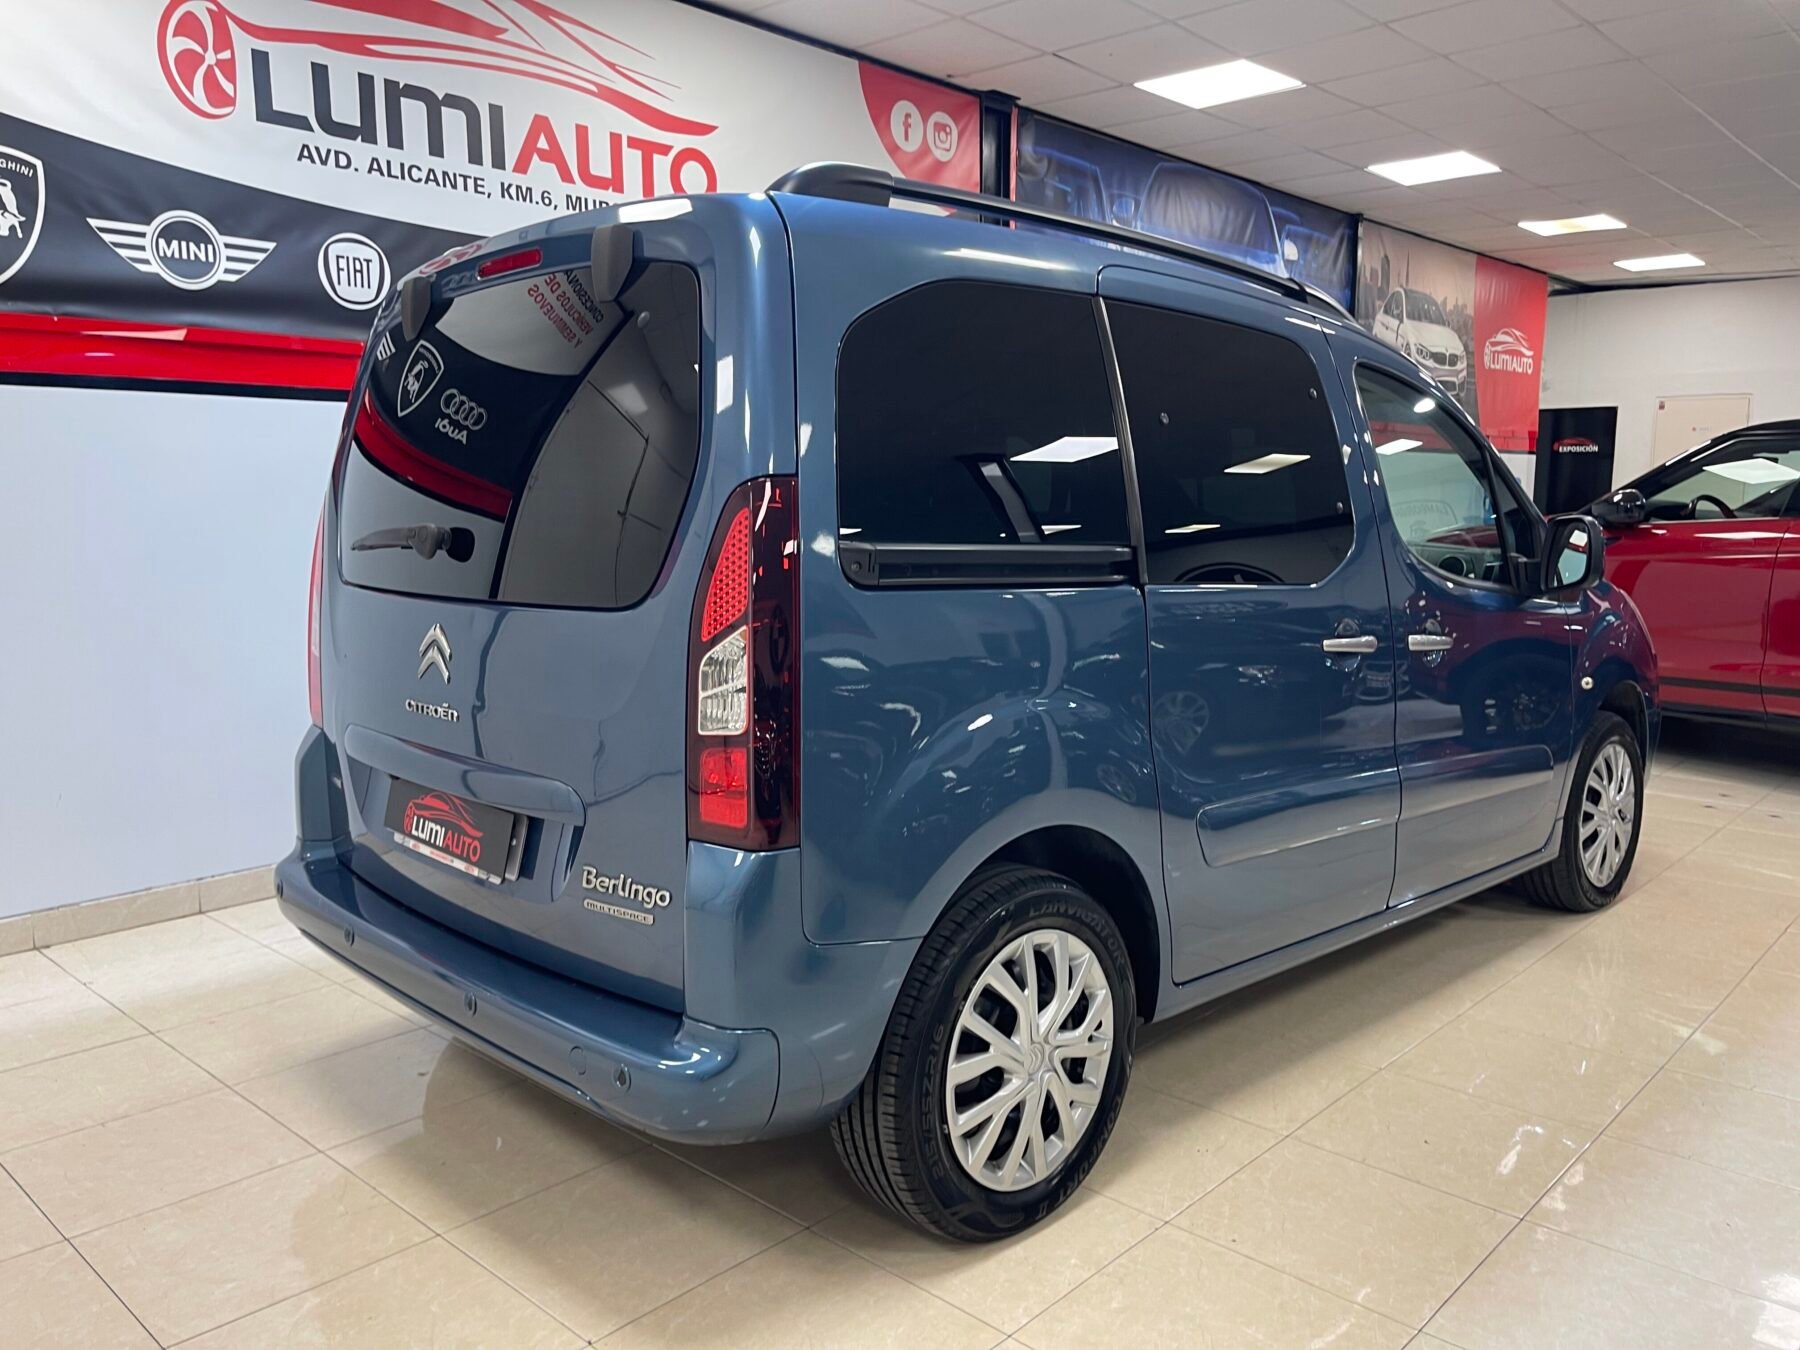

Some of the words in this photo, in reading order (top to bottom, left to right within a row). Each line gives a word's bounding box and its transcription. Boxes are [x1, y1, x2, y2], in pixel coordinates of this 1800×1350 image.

[297, 143, 359, 173] AVD.
[367, 157, 492, 199] ALICANTE,
[500, 182, 558, 212] KM.6,
[158, 238, 214, 264] MINI
[336, 255, 373, 290] FIAT
[1490, 352, 1534, 375] LUMIAUTO
[582, 865, 671, 909] Berlingo
[586, 901, 651, 923] MULTISPACE
